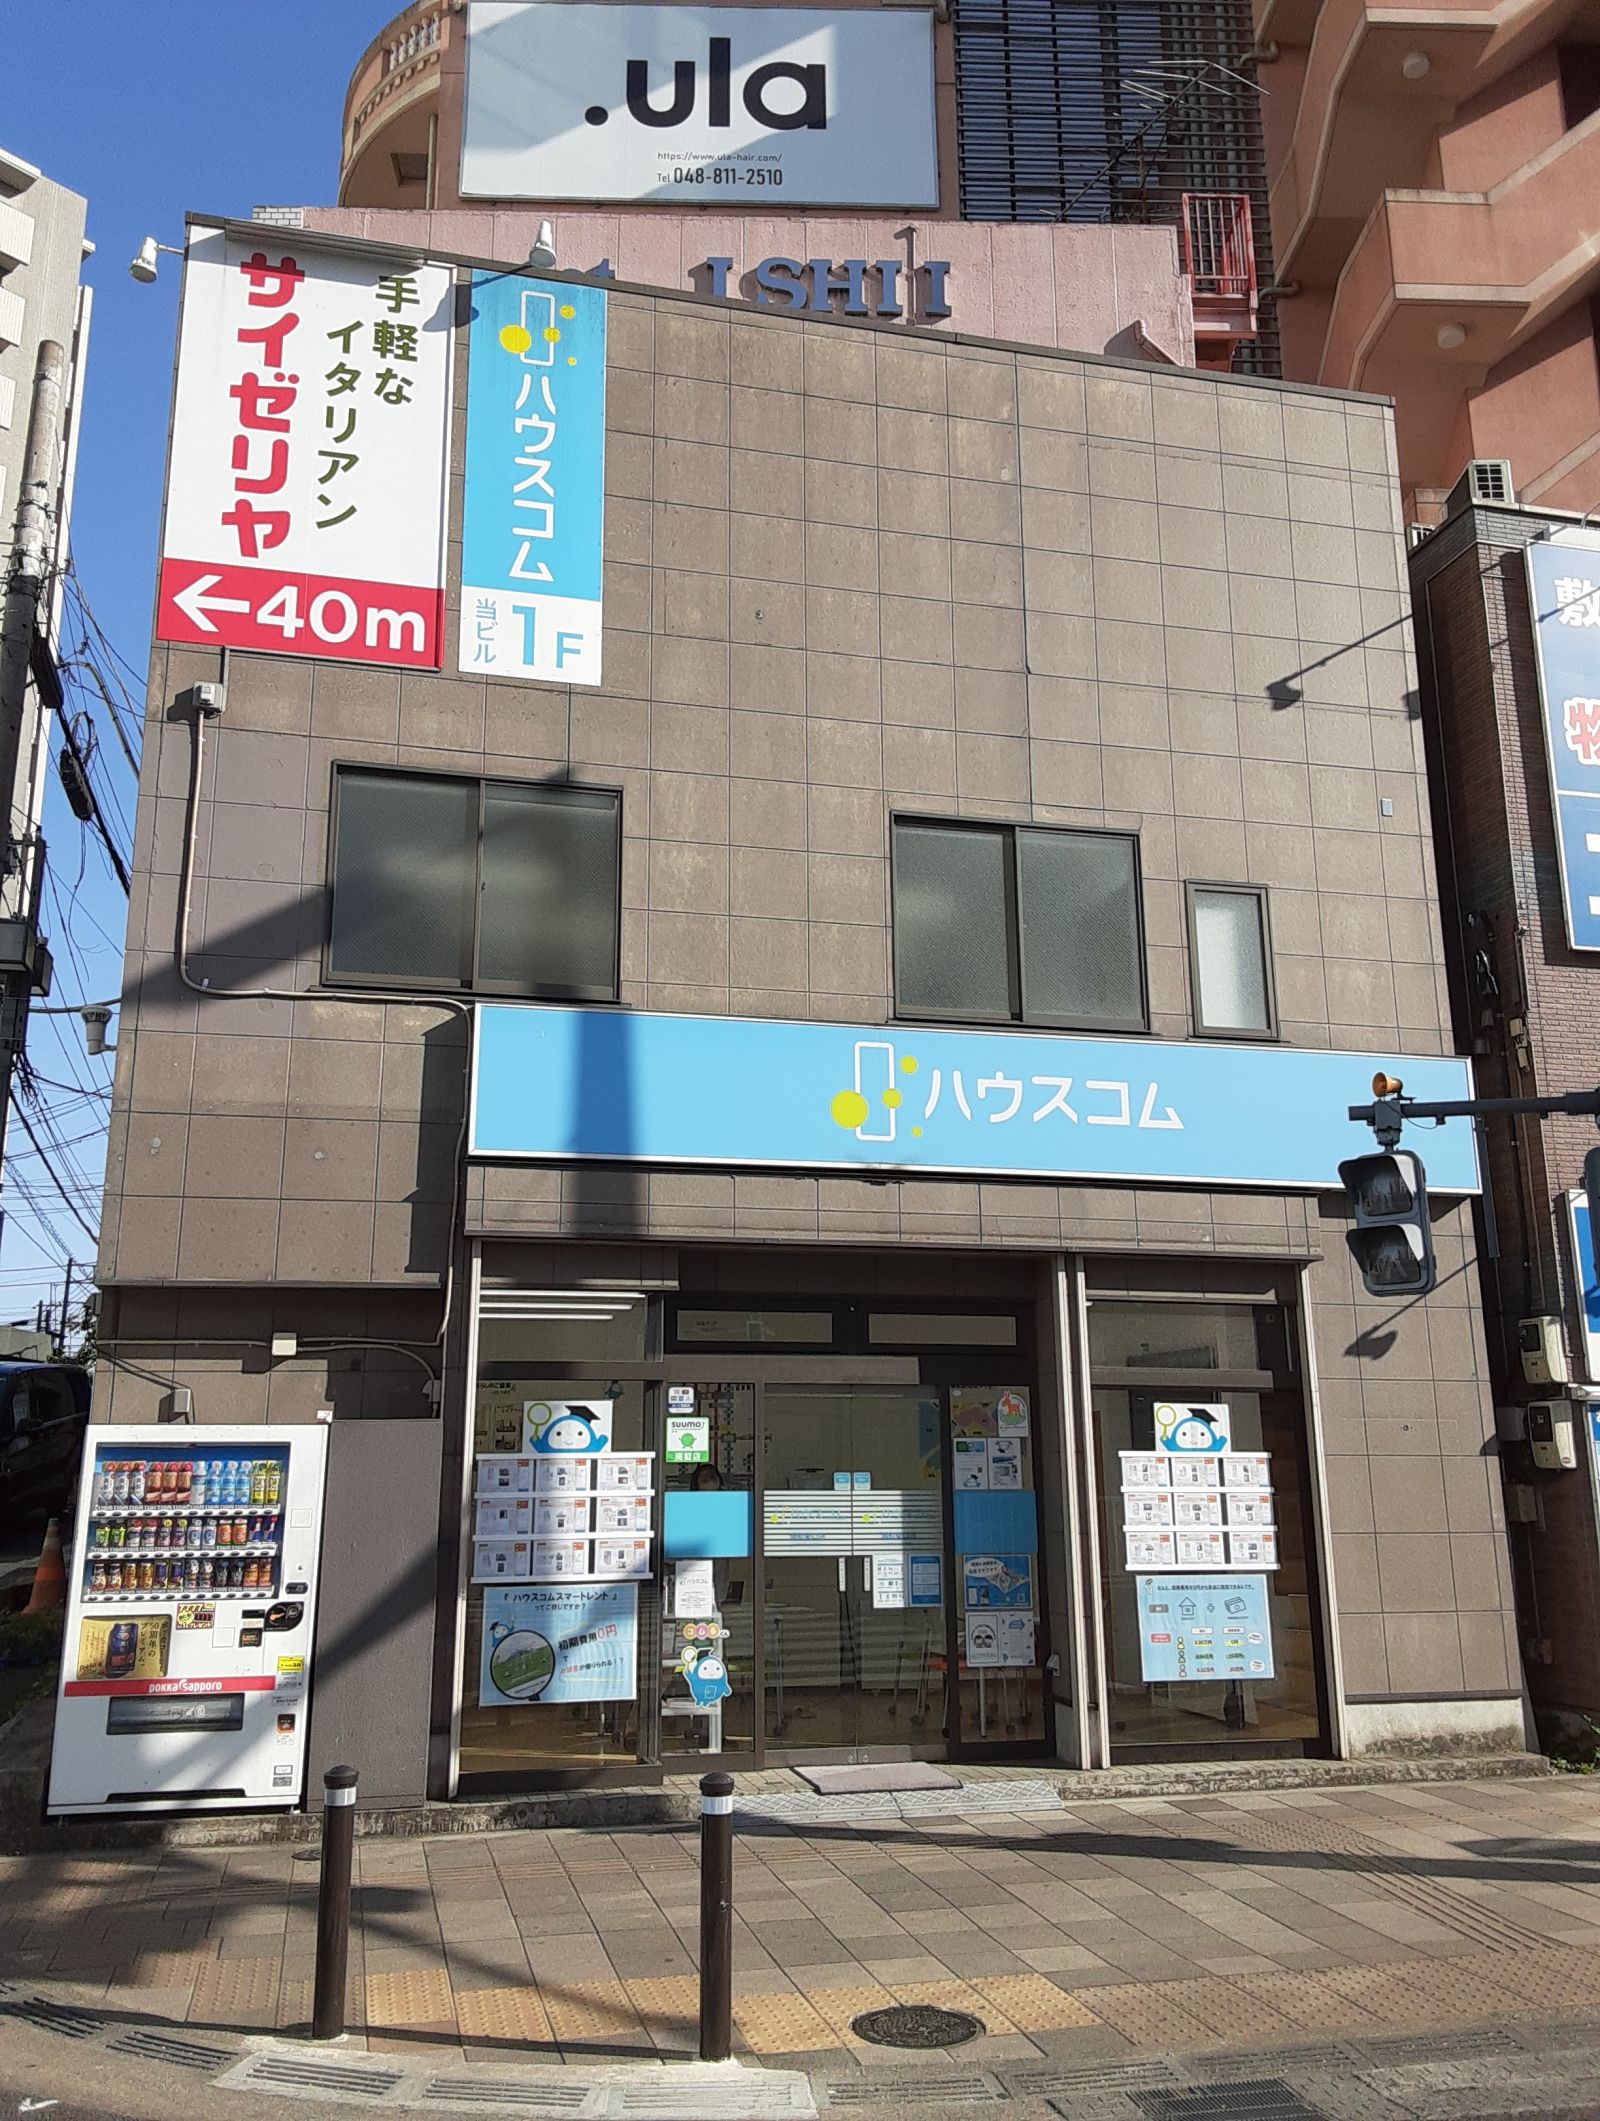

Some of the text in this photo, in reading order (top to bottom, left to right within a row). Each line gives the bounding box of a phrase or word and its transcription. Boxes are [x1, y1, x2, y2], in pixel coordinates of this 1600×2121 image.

[584, 37, 827, 131] .ula
[657, 152, 783, 163] https://www.ula-hair.com/
[657, 167, 783, 186] Tel 048-811-2510
[372, 275, 421, 407] 手軽な
[221, 252, 306, 559] サイゼリヤ
[315, 320, 364, 532] イタリアン
[508, 372, 556, 583] ハウスコム
[256, 588, 427, 654] 40m
[472, 598, 498, 666] 当ビル
[512, 606, 584, 669] 1F
[924, 1068, 1185, 1130] ハウスコム
